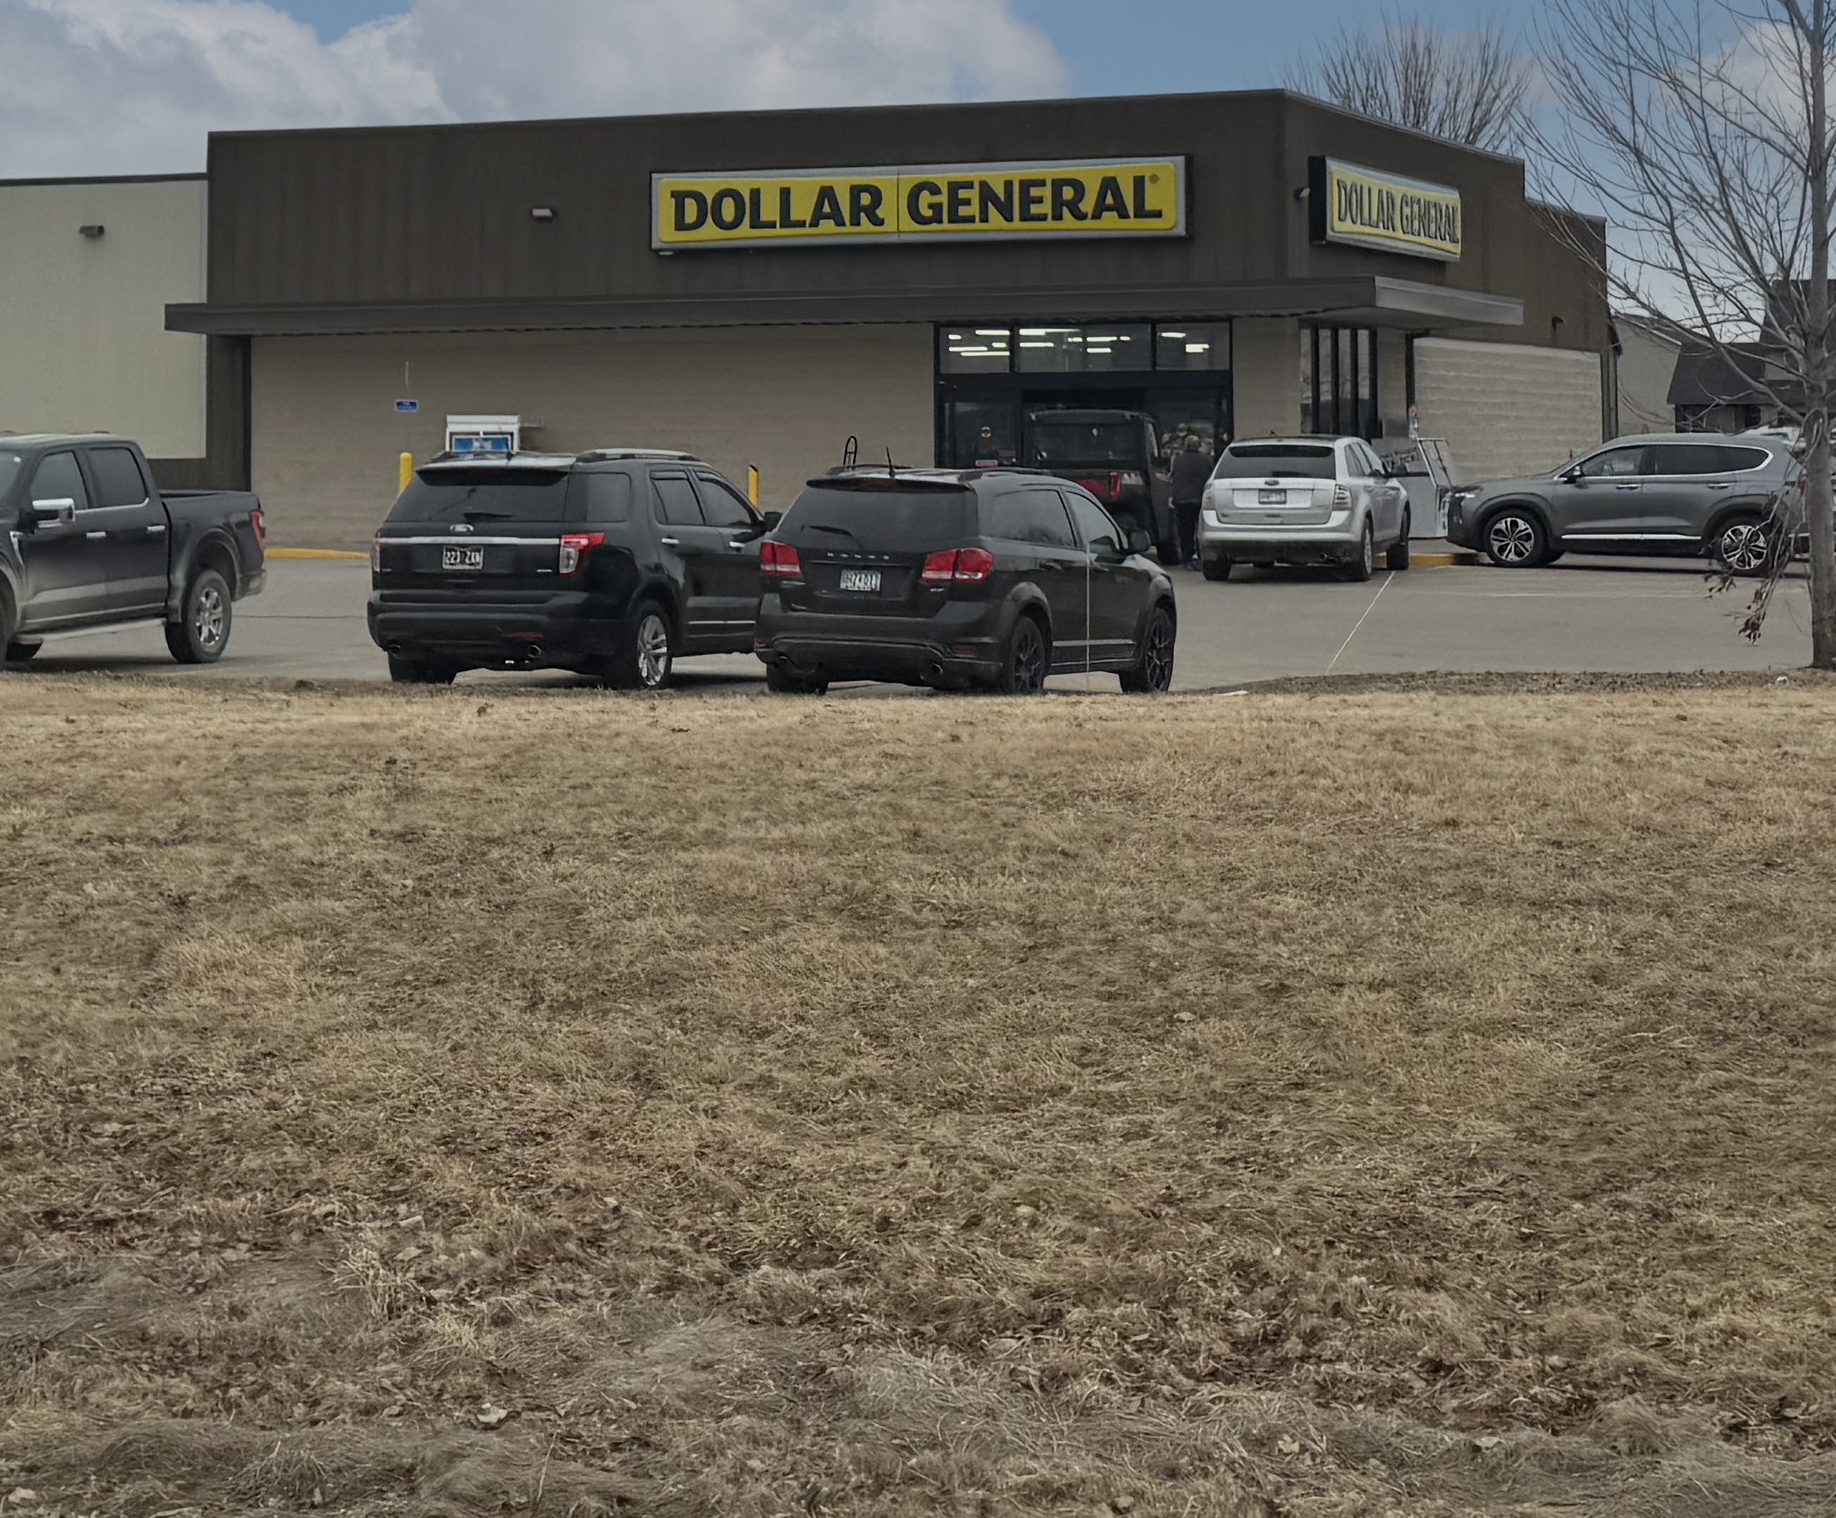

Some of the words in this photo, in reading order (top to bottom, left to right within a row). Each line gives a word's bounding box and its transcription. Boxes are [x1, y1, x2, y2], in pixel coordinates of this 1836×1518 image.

[670, 183, 885, 231] DOLLAR
[906, 174, 1163, 225] GENERAL
[1337, 179, 1396, 232] DOLLAR
[1400, 193, 1459, 244] GENERAL
